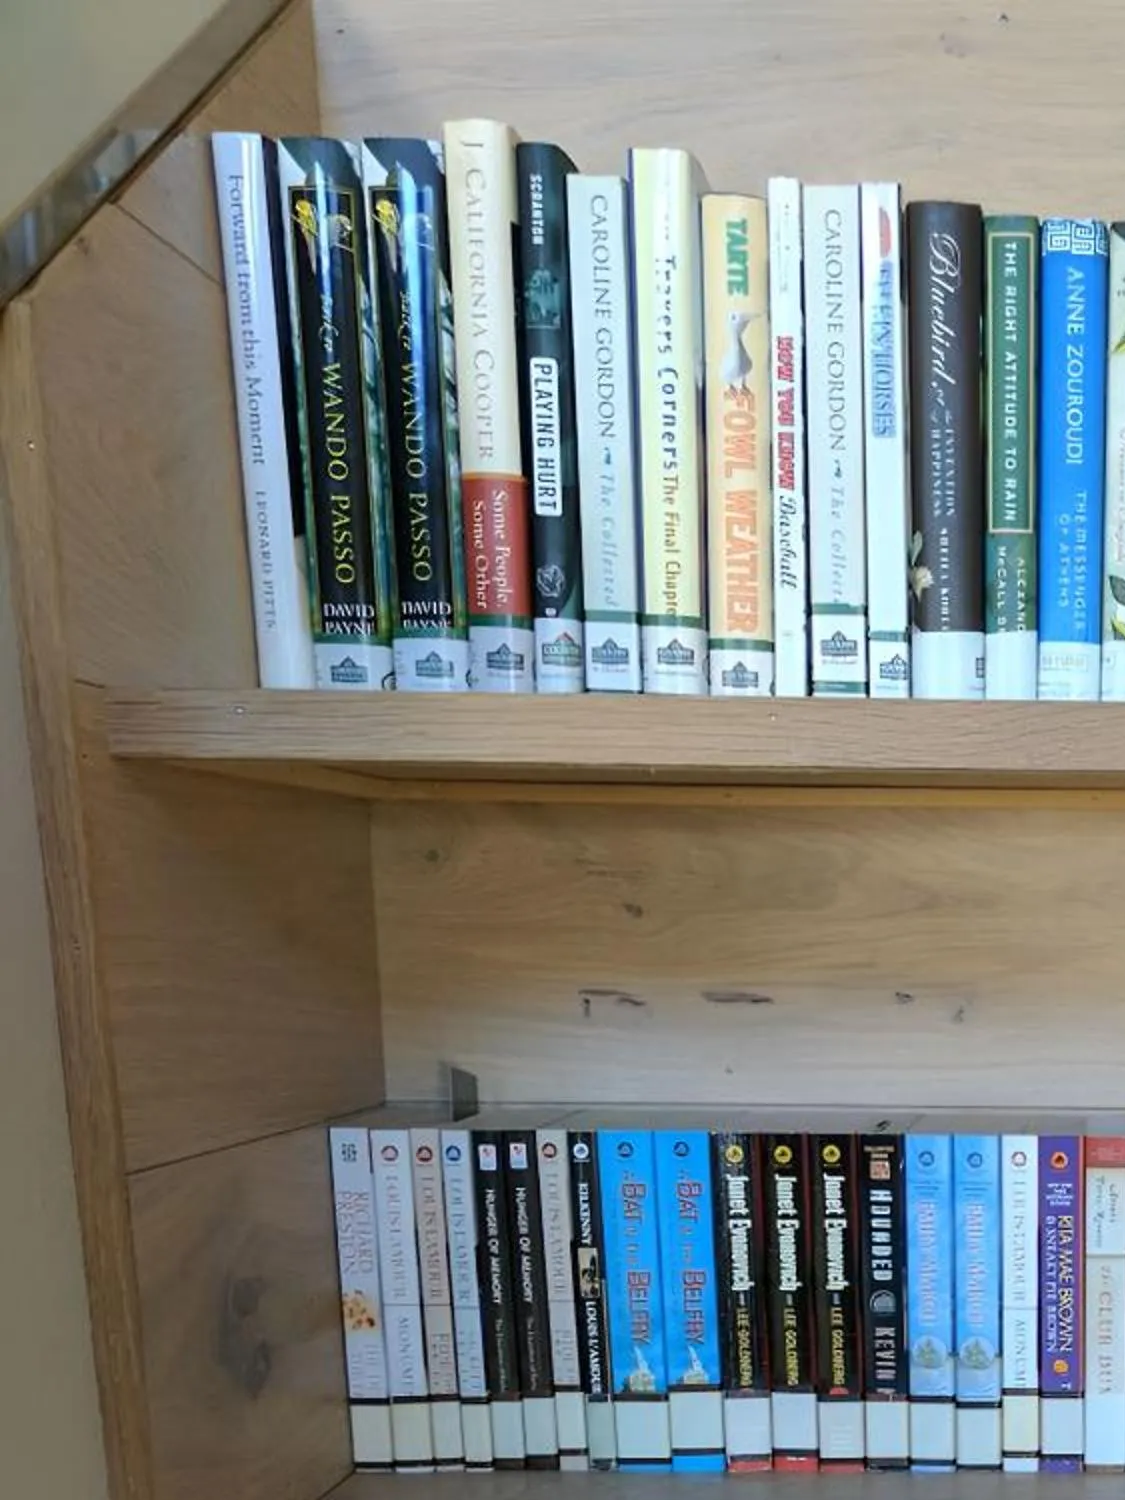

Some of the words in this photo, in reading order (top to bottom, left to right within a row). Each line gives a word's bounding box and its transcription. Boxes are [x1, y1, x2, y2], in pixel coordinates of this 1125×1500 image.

[227, 173, 251, 266] Forward
[464, 164, 491, 338] CALIFORNIA
[590, 194, 613, 317] CAROLINE
[724, 217, 750, 297] TARTE
[823, 209, 844, 332] CAROLINE
[1004, 241, 1017, 277] THE
[236, 270, 254, 326] from
[1004, 283, 1018, 343] RIGHT
[1065, 265, 1085, 339] ANNE
[240, 328, 263, 370] this
[595, 326, 617, 440] GORDON
[245, 376, 268, 466] Moment
[313, 363, 346, 480] WANDO
[400, 362, 430, 480] WANDO
[472, 348, 495, 461] COOPER
[531, 363, 556, 450] PLAYING
[657, 367, 680, 475] Corners
[826, 341, 847, 452] GORDON
[1004, 350, 1018, 439] ATTITUDE
[1065, 344, 1085, 466] ZOUROUDI
[722, 393, 757, 480] FOWL
[1004, 444, 1018, 470] TO
[471, 498, 488, 546] Some
[491, 490, 508, 540] Some
[536, 459, 558, 512] HURT
[661, 475, 677, 508] The
[1003, 474, 1018, 523] RAIN
[327, 493, 356, 585] PASSO
[406, 491, 433, 583] PASSO
[662, 510, 680, 556] Final
[723, 488, 760, 634] WEATHER
[777, 495, 799, 590] Baseball
[323, 603, 375, 618] DAVID
[401, 601, 452, 617] DAVID
[474, 547, 489, 608] Other
[324, 620, 376, 636] PAYNE
[621, 1182, 647, 1224] BAT
[676, 1181, 704, 1224] BAT
[725, 1173, 751, 1215] Janet
[774, 1172, 798, 1215] Janet
[822, 1172, 847, 1214] Janet
[728, 1218, 756, 1291] Evanovich
[776, 1218, 803, 1291] Evanovich
[825, 1218, 851, 1291] Evanovich
[868, 1188, 894, 1281] HOUNDED
[1057, 1215, 1074, 1245] RITA
[1057, 1248, 1074, 1285] MAE
[682, 1269, 707, 1346] BELFRY
[1057, 1287, 1075, 1353] BROWN
[873, 1326, 897, 1380] KEVIN
